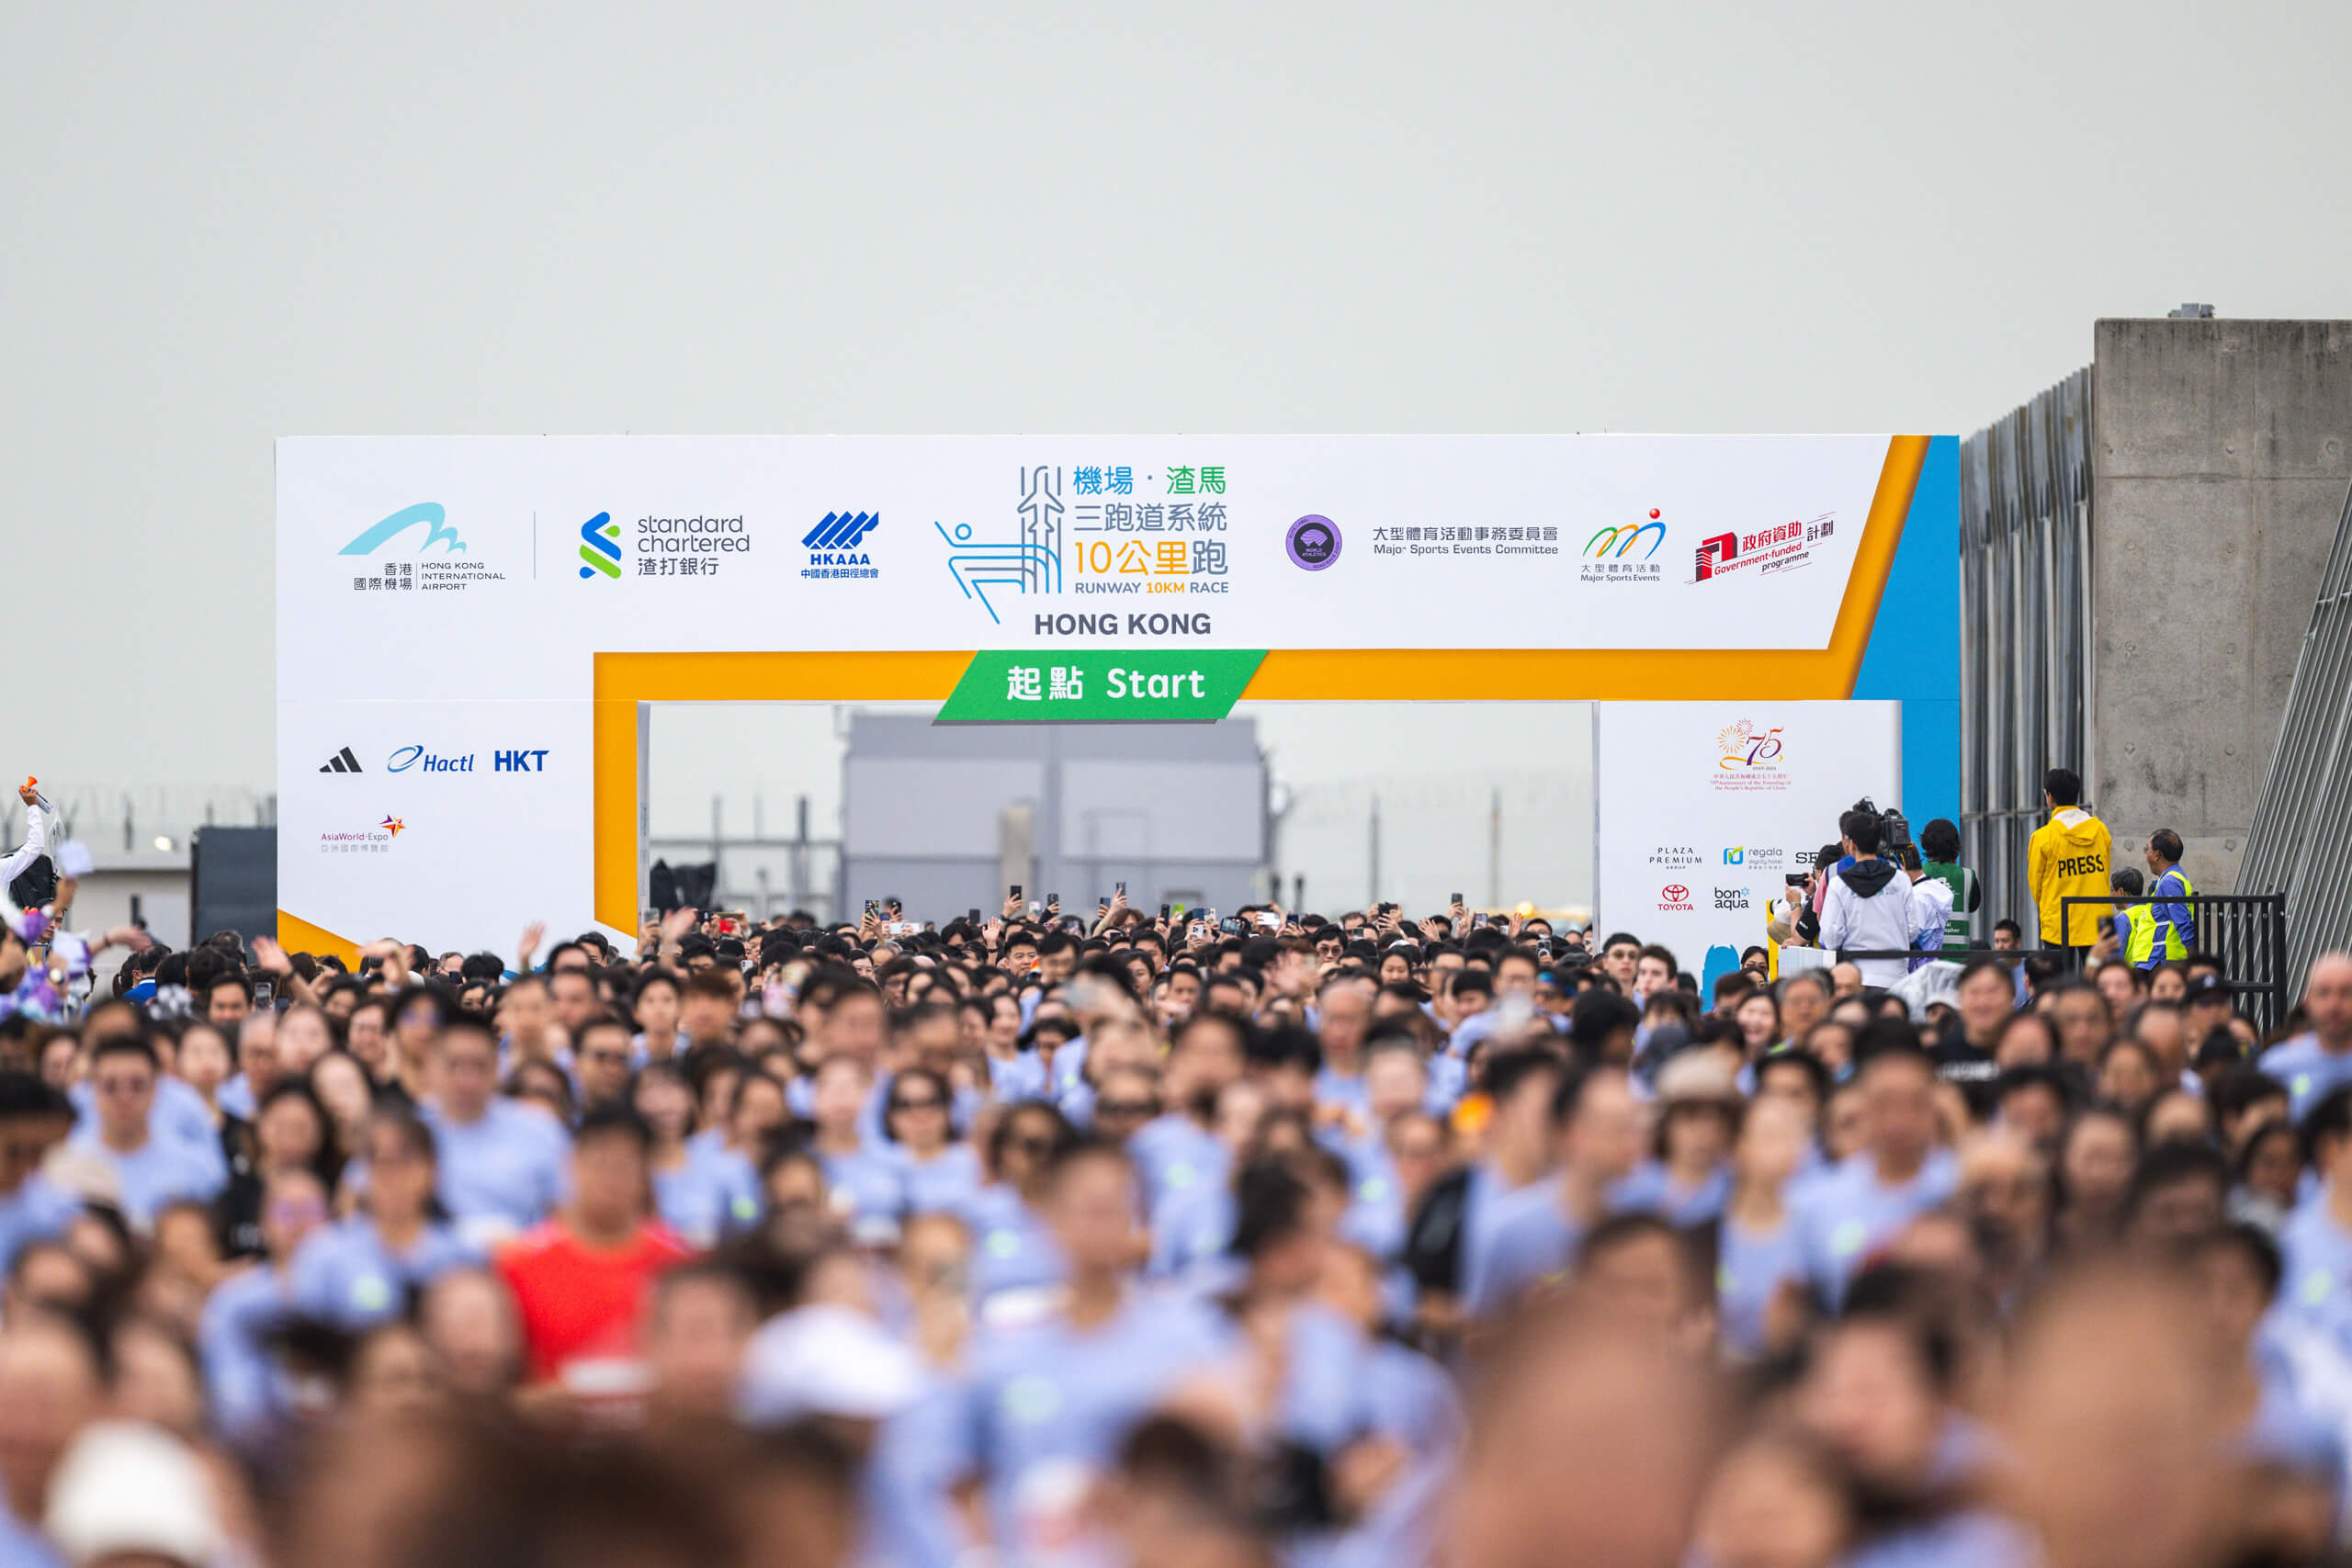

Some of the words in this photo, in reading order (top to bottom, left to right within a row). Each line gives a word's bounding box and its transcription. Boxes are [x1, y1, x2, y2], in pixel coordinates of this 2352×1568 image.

[638, 514, 743, 533] standard
[1074, 502, 1227, 532] 三跑道系統
[1373, 526, 1558, 541] 大型體育活動事務委員會
[1742, 521, 1802, 552] 政府資助
[1806, 520, 1834, 542] 計劃
[638, 535, 751, 552] chartered
[1410, 544, 1449, 556] Sports
[1453, 544, 1492, 554] Events
[1495, 544, 1558, 554] Committee
[638, 558, 719, 576] 渣打銀行
[810, 554, 871, 565] HKAAA
[1075, 540, 1228, 576] 10公里跑
[1714, 542, 1802, 576] Government-funded
[1761, 551, 1810, 572] programme
[384, 563, 413, 576] 香港
[800, 568, 879, 579] 中國香港田徑總會
[1580, 574, 1604, 582] Major
[1606, 574, 1632, 582] Sports
[354, 578, 413, 591] 國際機場
[1075, 581, 1141, 593] RUNWAY
[1147, 581, 1185, 593] 10KM
[1190, 581, 1229, 593] RACE
[1035, 614, 1118, 636] HONG
[1128, 614, 1212, 636] KONG
[1007, 666, 1084, 700] 起點
[1106, 668, 1205, 699] Start
[1746, 726, 1784, 766] 75
[423, 754, 474, 772] Hactl
[494, 750, 550, 772] HKT
[321, 832, 390, 842] AsiaWorld-Expo
[1748, 847, 1783, 858] regala
[2058, 854, 2105, 878] PRESS
[1714, 887, 1741, 898] bon
[1714, 899, 1749, 911] aqua
